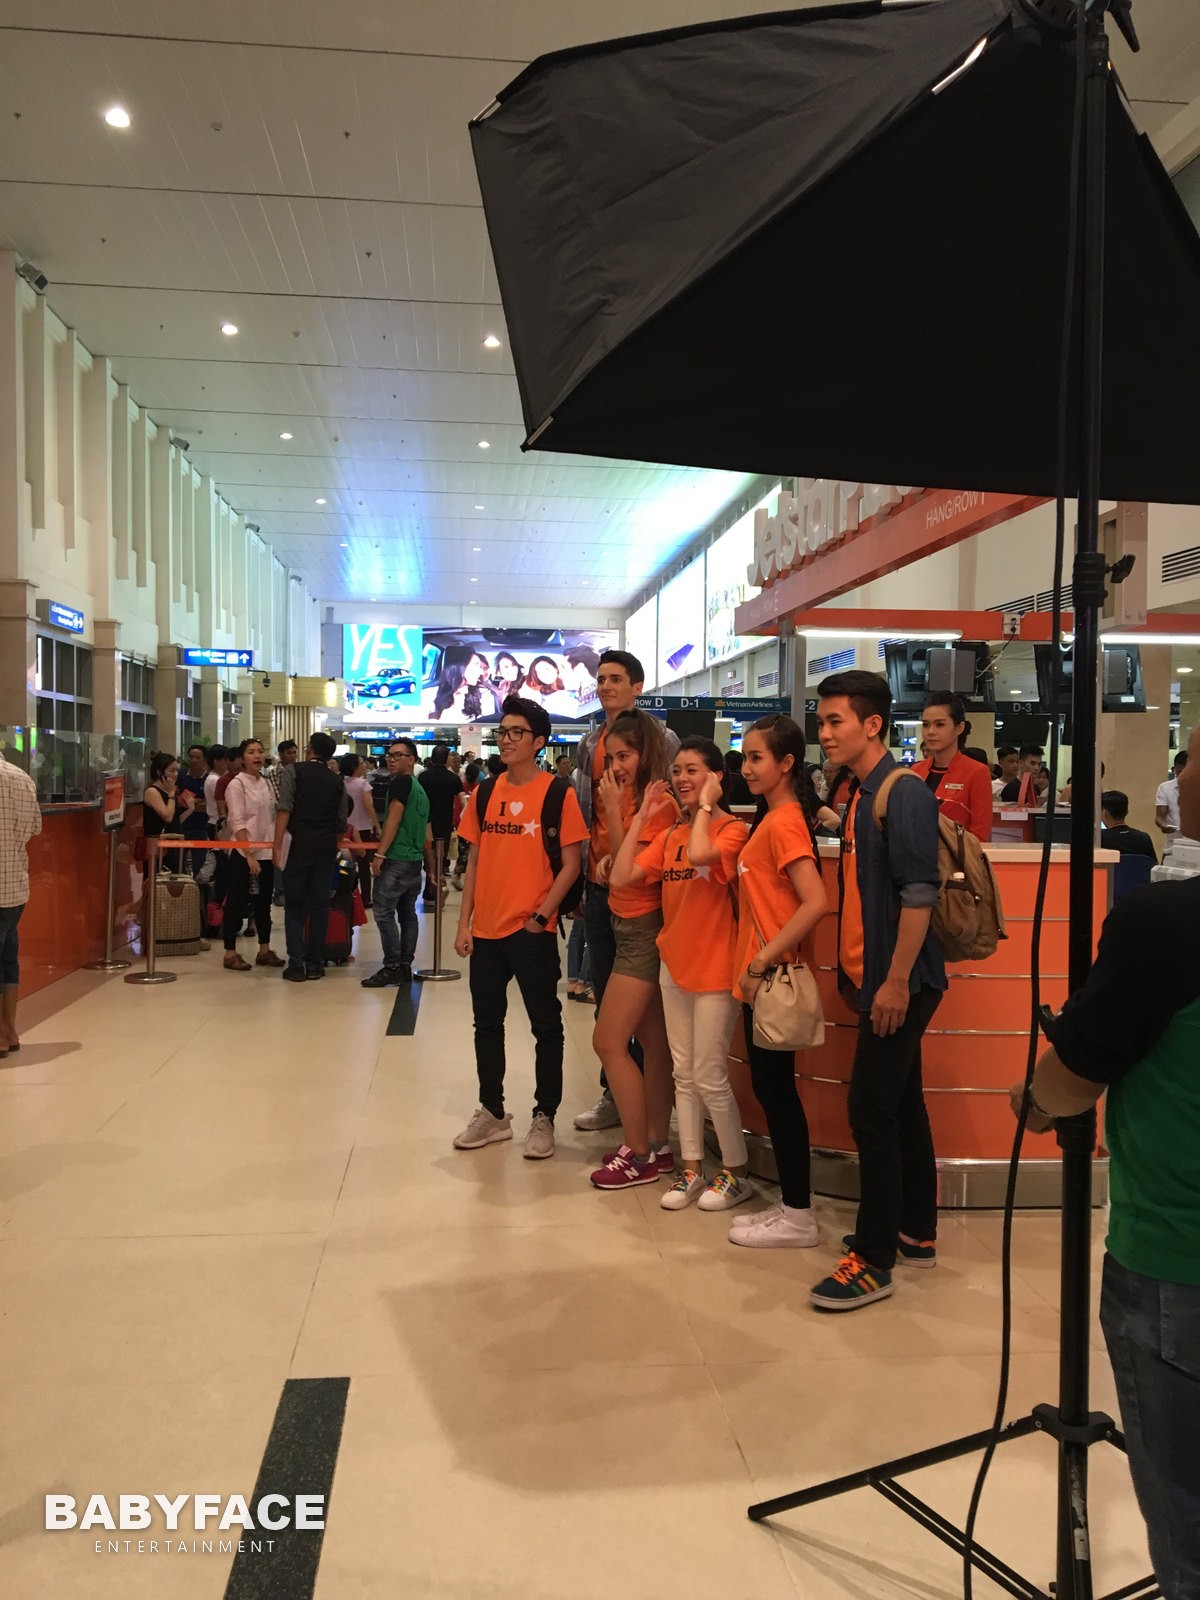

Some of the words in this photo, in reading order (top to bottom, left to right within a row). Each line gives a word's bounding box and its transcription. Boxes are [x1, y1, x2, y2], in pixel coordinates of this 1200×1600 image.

[350, 624, 420, 672] YES
[655, 697, 664, 708] D
[680, 697, 699, 708] D-1
[1012, 702, 1032, 712] D-3
[499, 801, 507, 816] I
[480, 820, 523, 835] Jetstar
[674, 845, 684, 862] I
[663, 867, 694, 882] etstar
